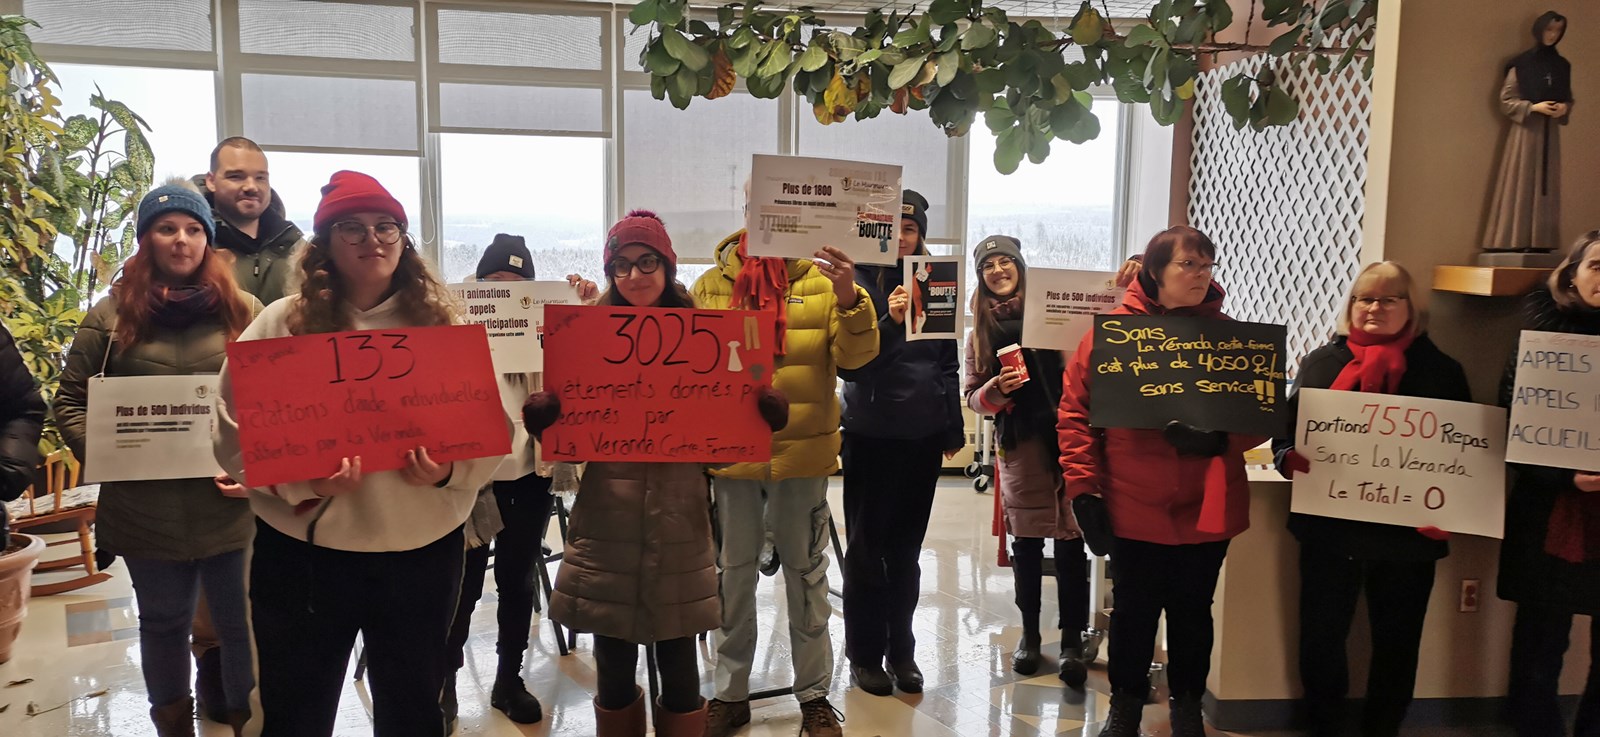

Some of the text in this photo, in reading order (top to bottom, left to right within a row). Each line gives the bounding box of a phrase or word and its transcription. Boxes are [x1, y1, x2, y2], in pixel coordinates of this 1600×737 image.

[782, 183, 832, 196] Plus de 1800
[467, 288, 511, 299] animations
[1046, 291, 1115, 303] Plus de 500 individus
[469, 304, 496, 315] appels
[603, 313, 724, 374] 3025
[1102, 320, 1166, 344] Sans
[1137, 341, 1155, 353] La
[327, 334, 415, 384] 133
[1097, 357, 1123, 374] c'est
[1129, 356, 1159, 376] plus
[1170, 353, 1193, 369] de
[1198, 353, 1249, 372] 4050
[1520, 350, 1592, 373] APPELS
[671, 376, 732, 399] donnés
[1512, 386, 1580, 410] APPELS
[115, 403, 211, 416] Plus de 500 individus
[241, 400, 329, 430] relations
[643, 410, 675, 441] par
[1304, 403, 1490, 453] portions 7550 Repas
[1510, 423, 1600, 451] ACCUEIL
[553, 434, 576, 456] La
[1314, 444, 1472, 477] Sans La Véranda
[1328, 480, 1348, 499] Le
[1358, 481, 1399, 504] Total
[1424, 486, 1445, 510] 0
